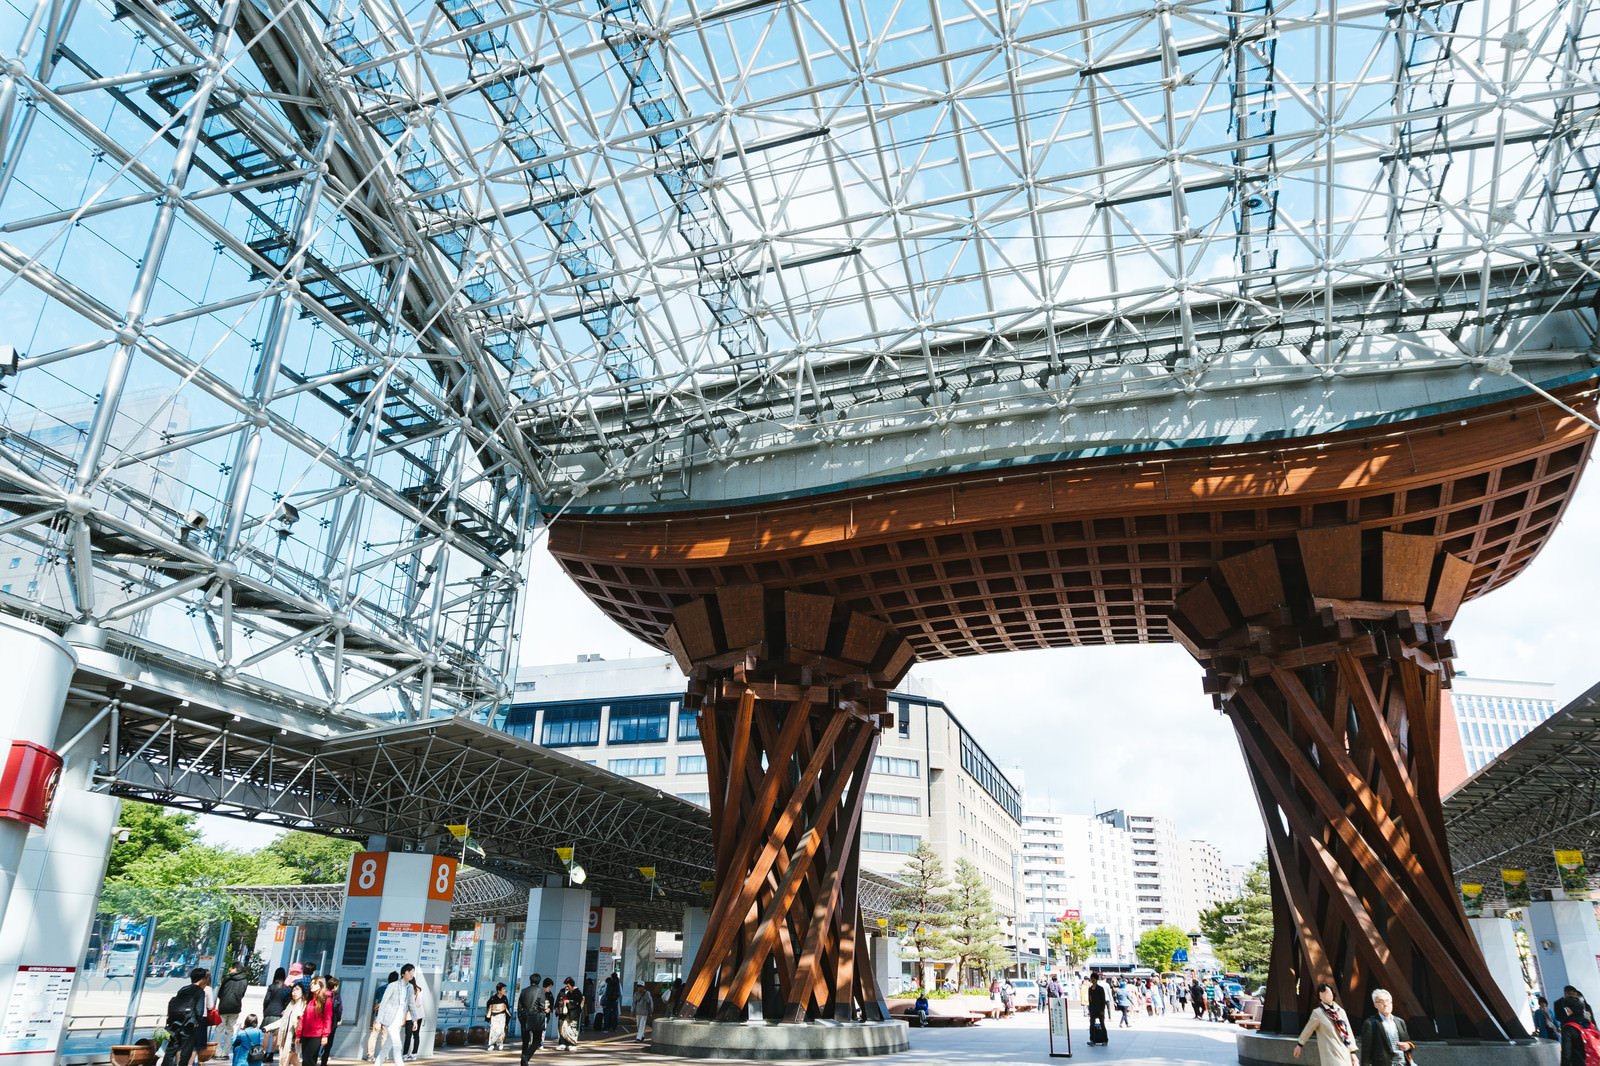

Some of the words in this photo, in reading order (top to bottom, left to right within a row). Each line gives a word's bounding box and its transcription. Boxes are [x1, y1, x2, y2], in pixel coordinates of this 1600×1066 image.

[359, 859, 377, 889] 8
[436, 863, 449, 893] 8
[588, 911, 599, 928] 9
[276, 927, 284, 940] 11
[496, 926, 506, 941] 10
